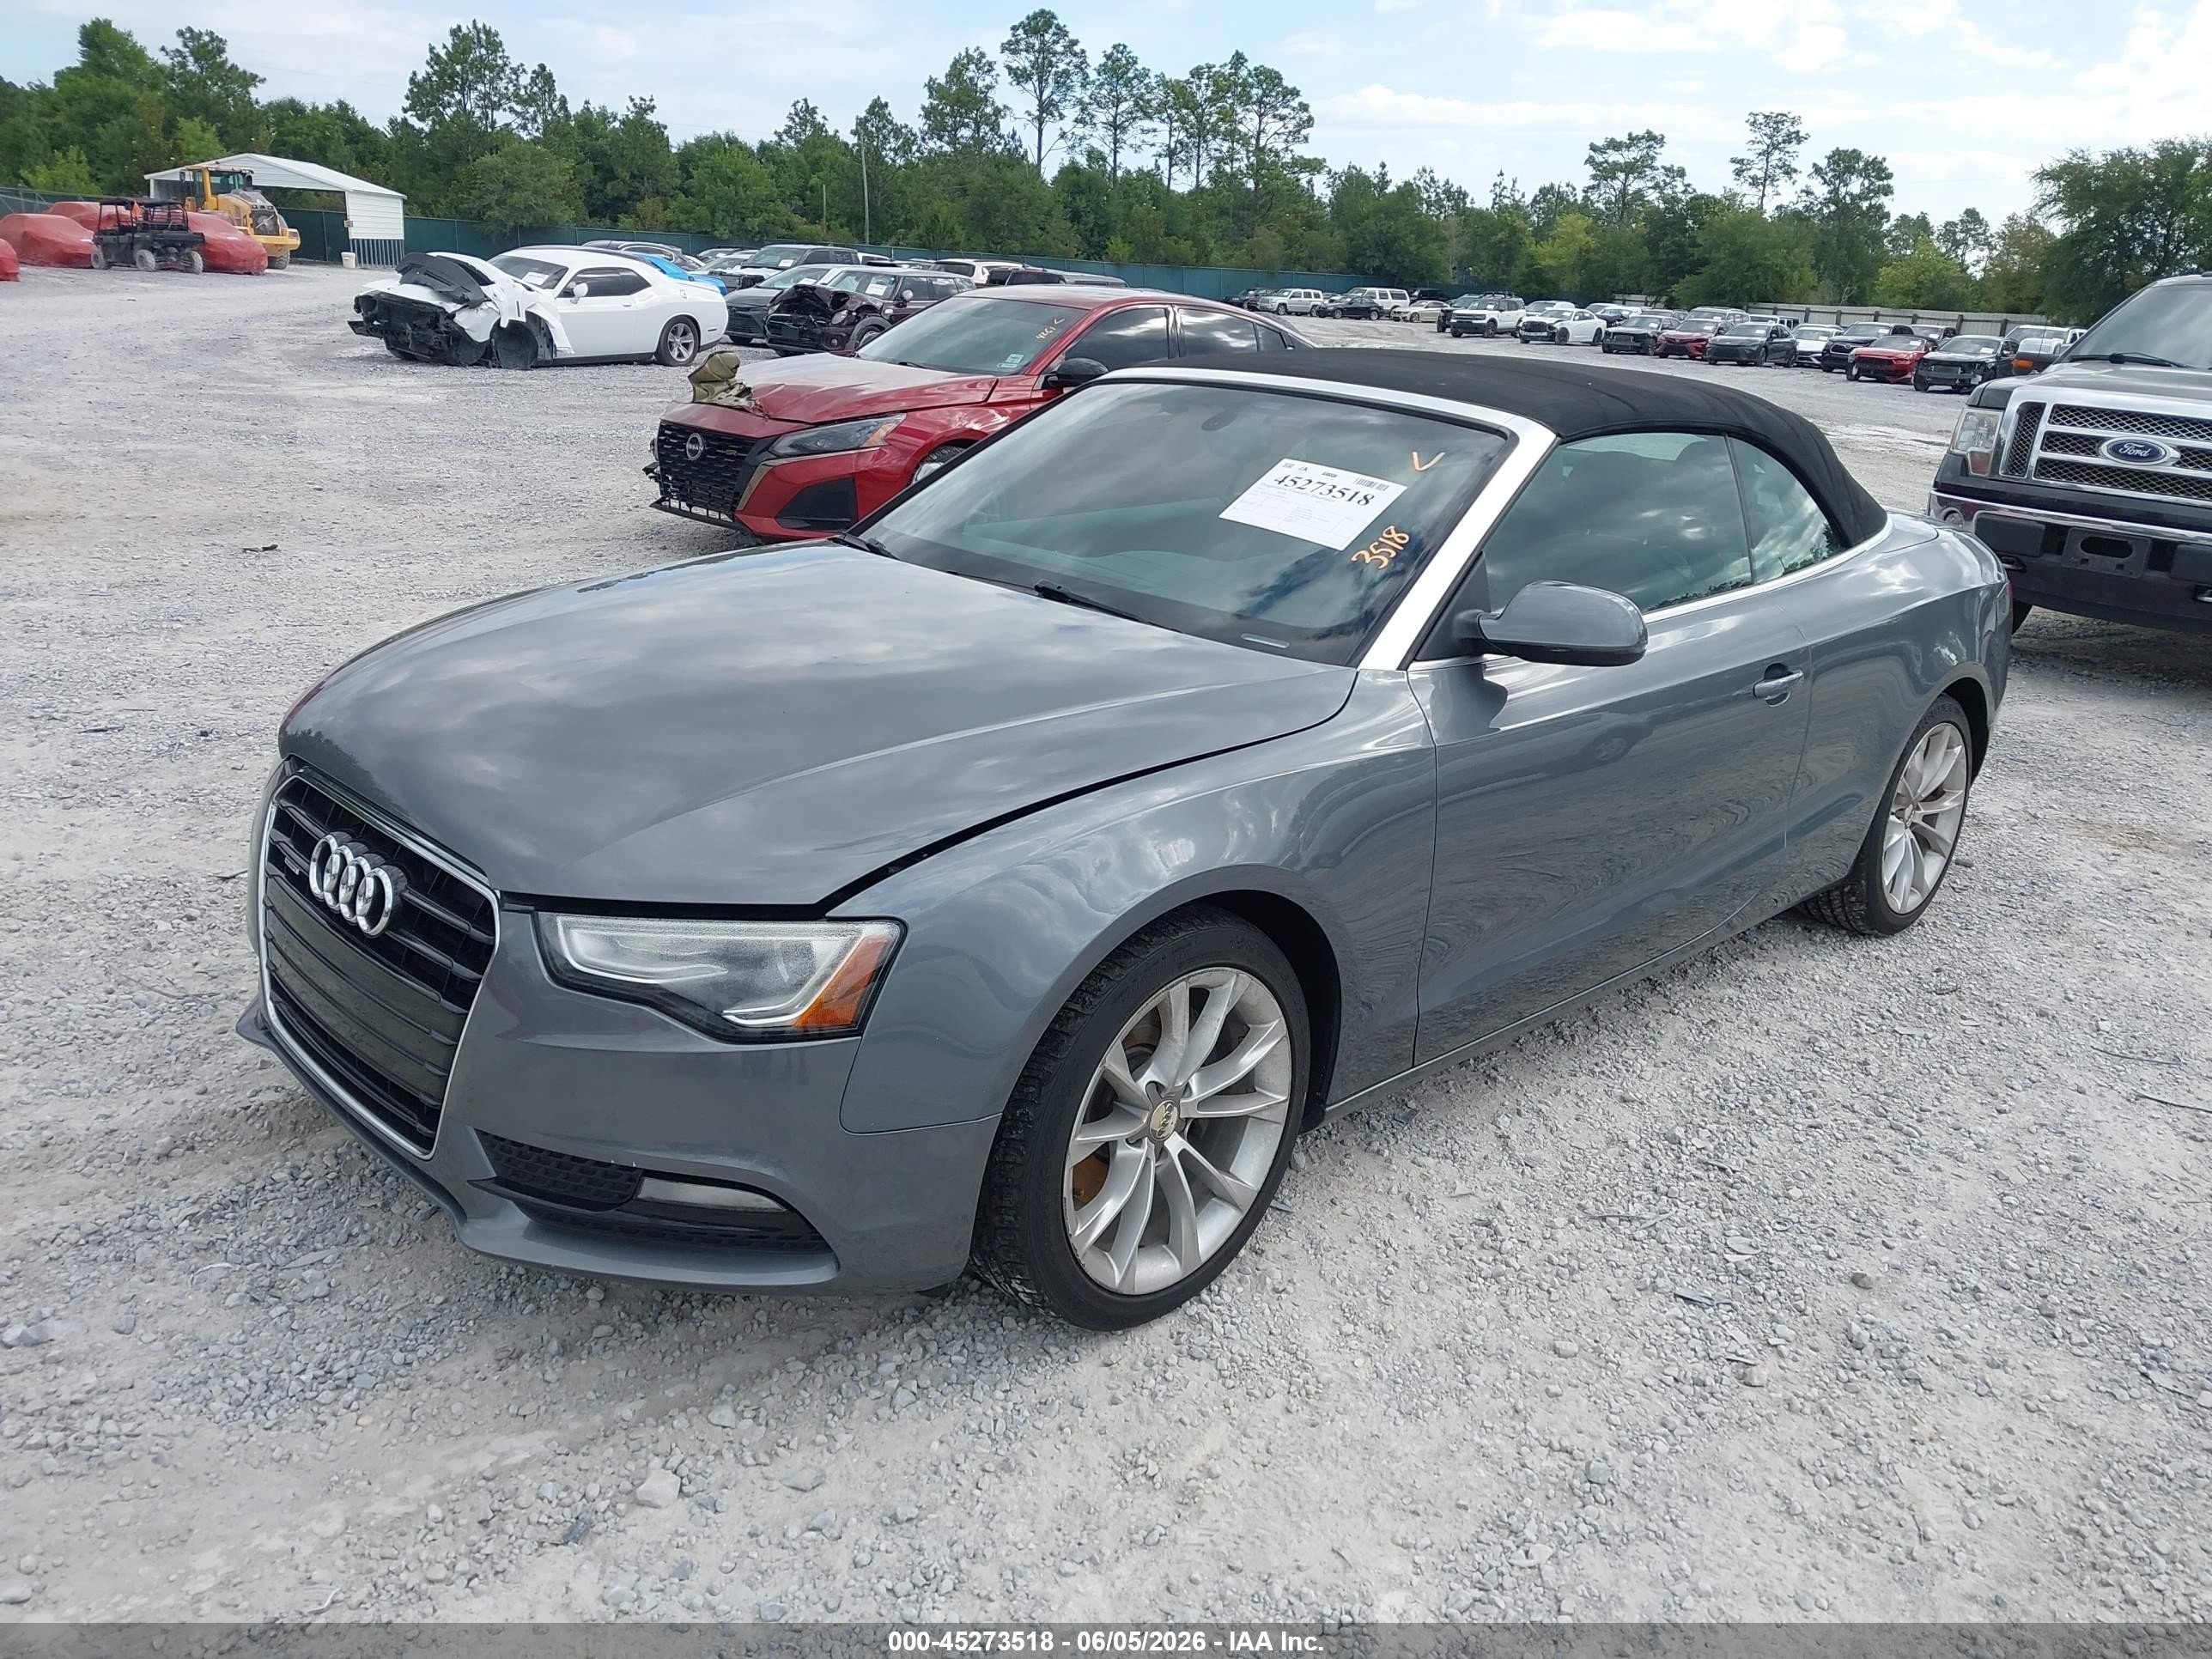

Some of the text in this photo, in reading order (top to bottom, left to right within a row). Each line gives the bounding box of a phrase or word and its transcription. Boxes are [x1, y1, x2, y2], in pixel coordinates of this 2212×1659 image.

[2118, 442, 2151, 458] Ford
[1273, 474, 1376, 507] 45273518
[1350, 525, 1412, 570] 3518
